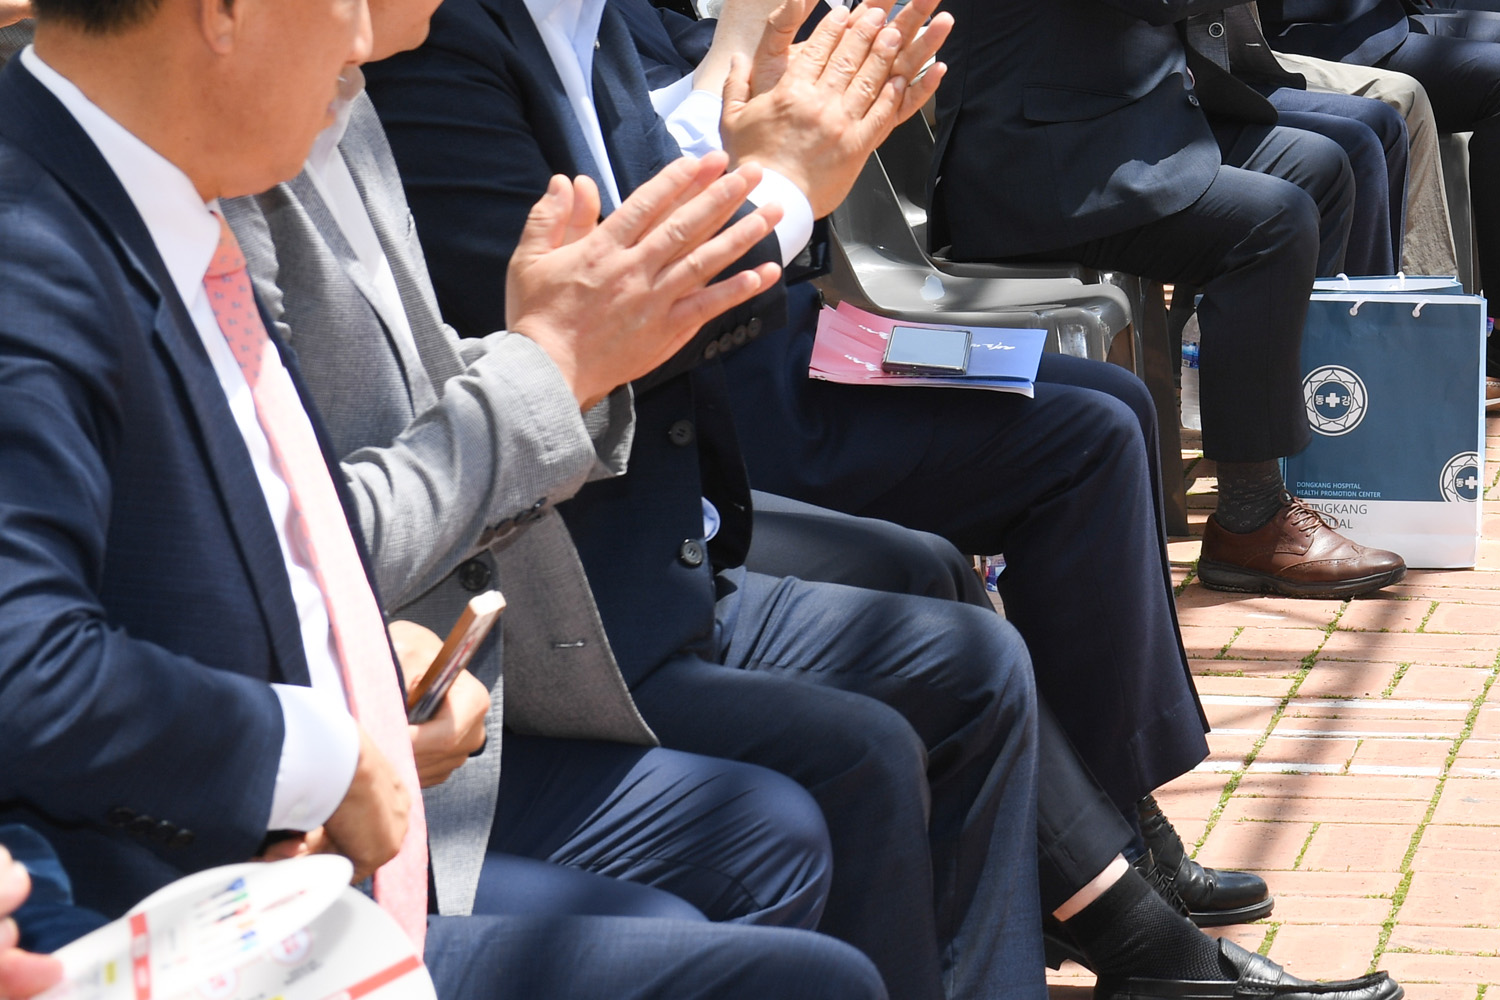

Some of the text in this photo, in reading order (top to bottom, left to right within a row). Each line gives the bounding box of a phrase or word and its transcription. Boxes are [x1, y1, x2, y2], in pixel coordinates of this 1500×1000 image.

[1315, 394, 1351, 406] 동 강
[1296, 481, 1332, 489] DONGKANG
[1456, 477, 1464, 488] 동
